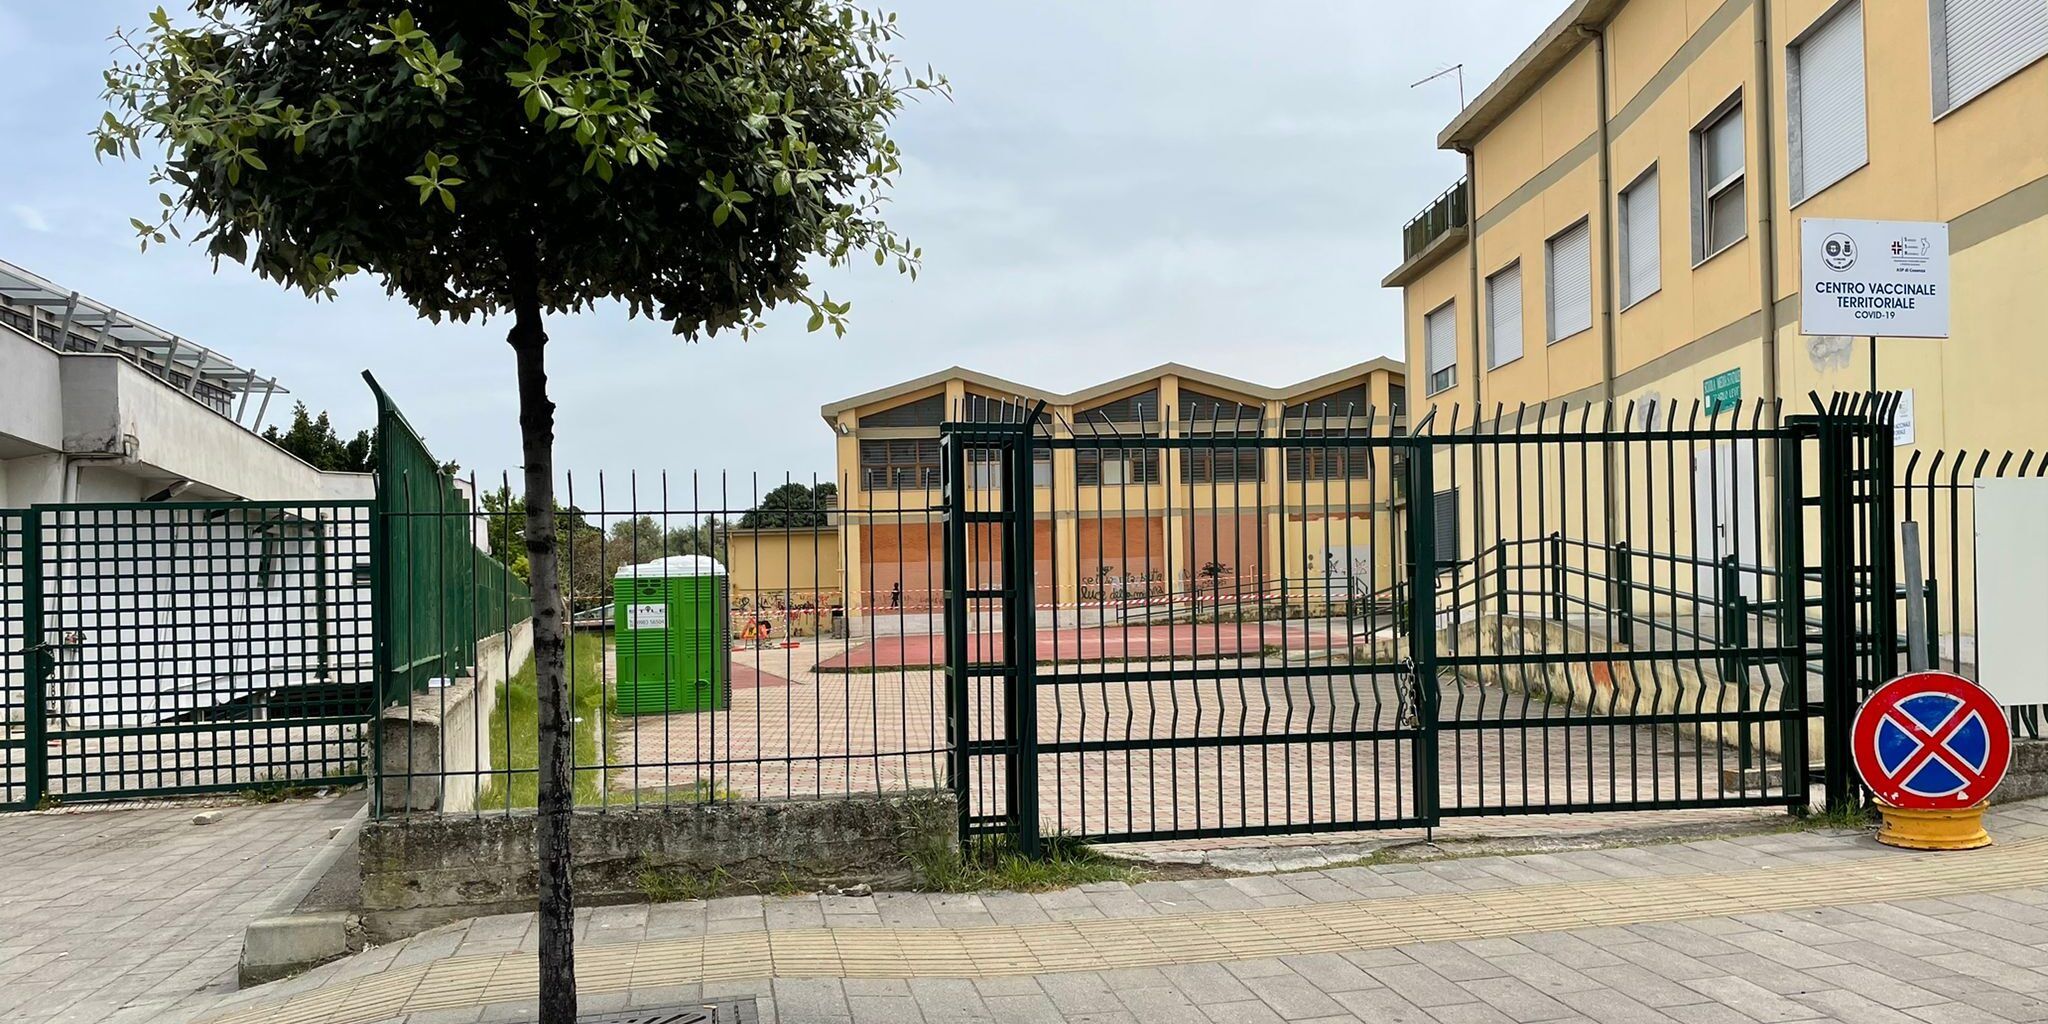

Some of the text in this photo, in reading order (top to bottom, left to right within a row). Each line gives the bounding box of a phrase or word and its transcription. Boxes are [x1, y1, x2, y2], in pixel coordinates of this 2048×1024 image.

[1815, 282, 1936, 296] CENTRO VACCINALE
[1837, 296, 1915, 309] TERRITORIALE
[1854, 311, 1896, 319] COVID-19
